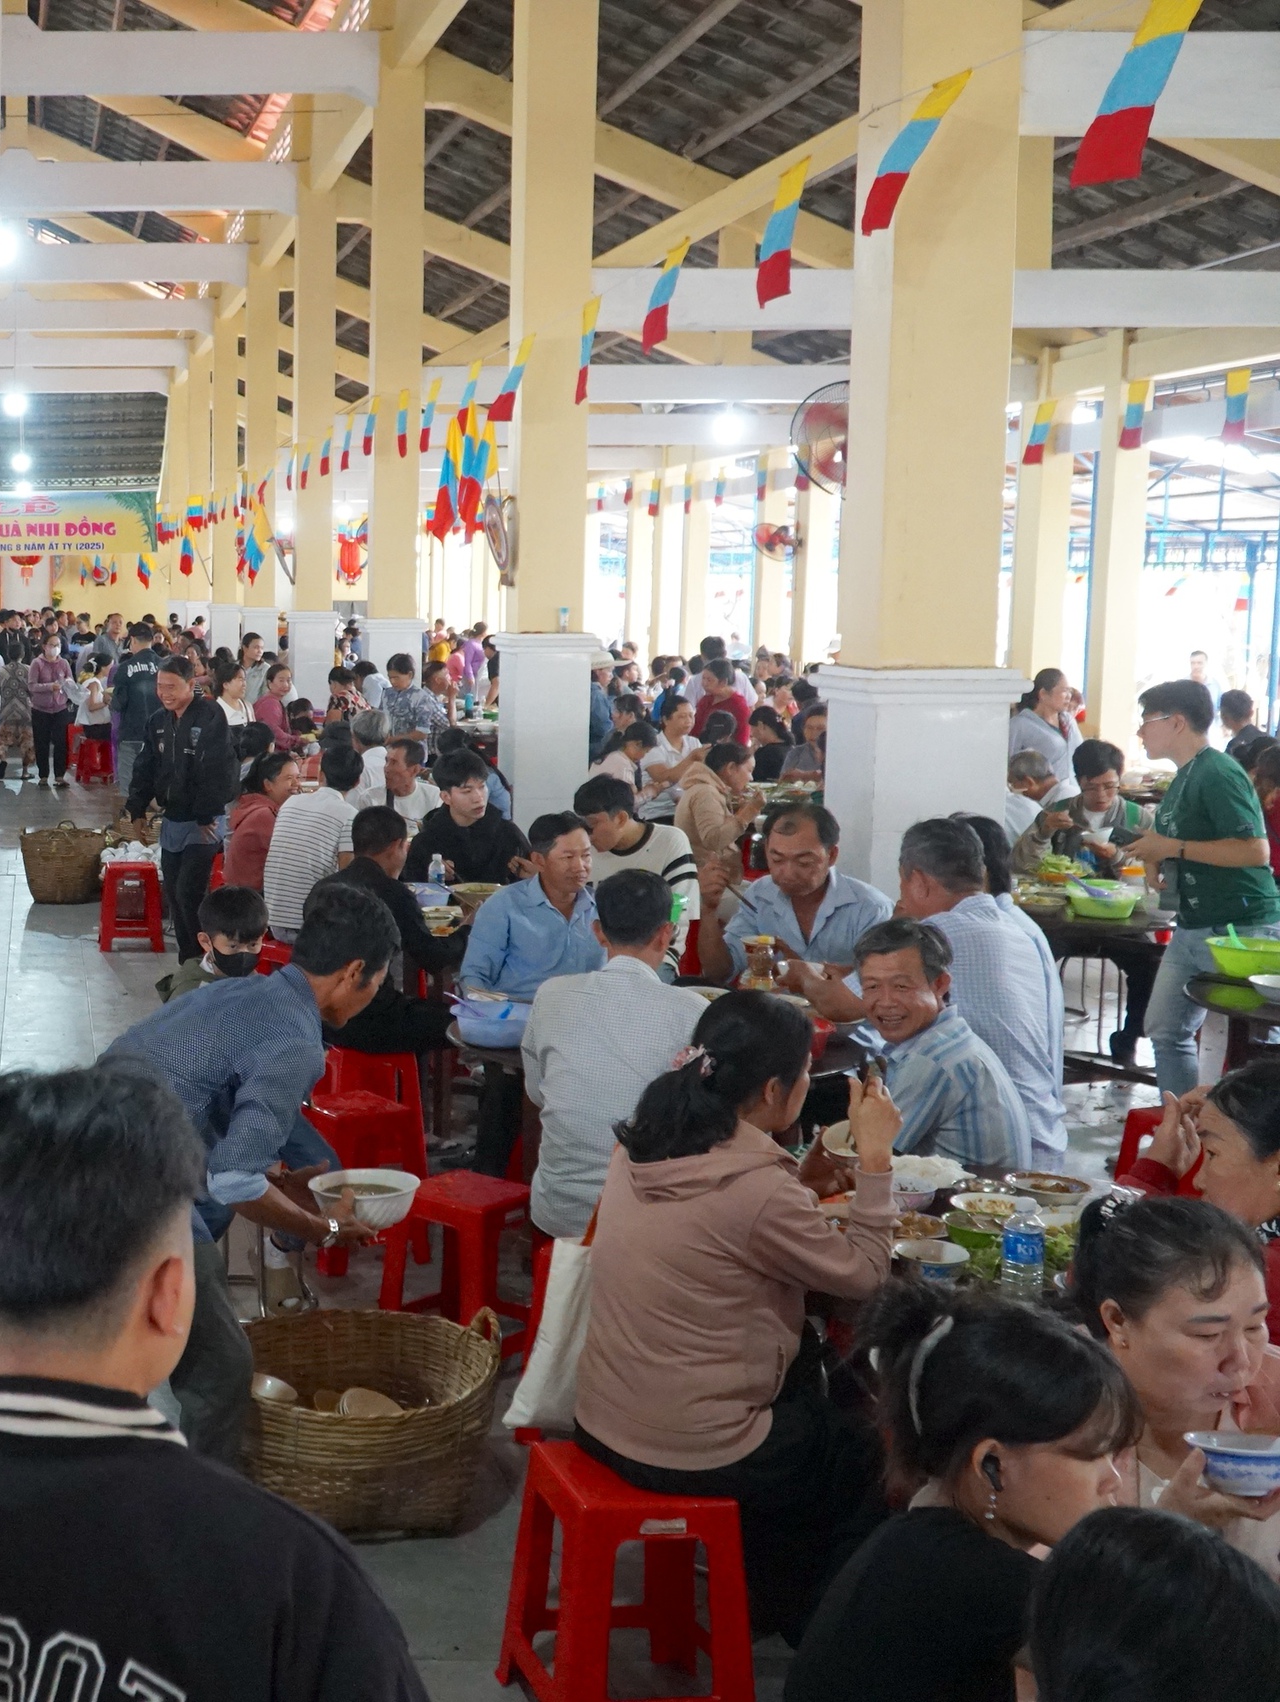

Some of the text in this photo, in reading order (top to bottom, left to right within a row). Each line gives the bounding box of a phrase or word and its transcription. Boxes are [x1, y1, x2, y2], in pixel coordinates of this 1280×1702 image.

[26, 523, 60, 537] NHI
[64, 515, 117, 536] ĐỒNG
[16, 543, 22, 551] 8
[75, 542, 105, 550] (2025)
[127, 661, 149, 678] Palm
